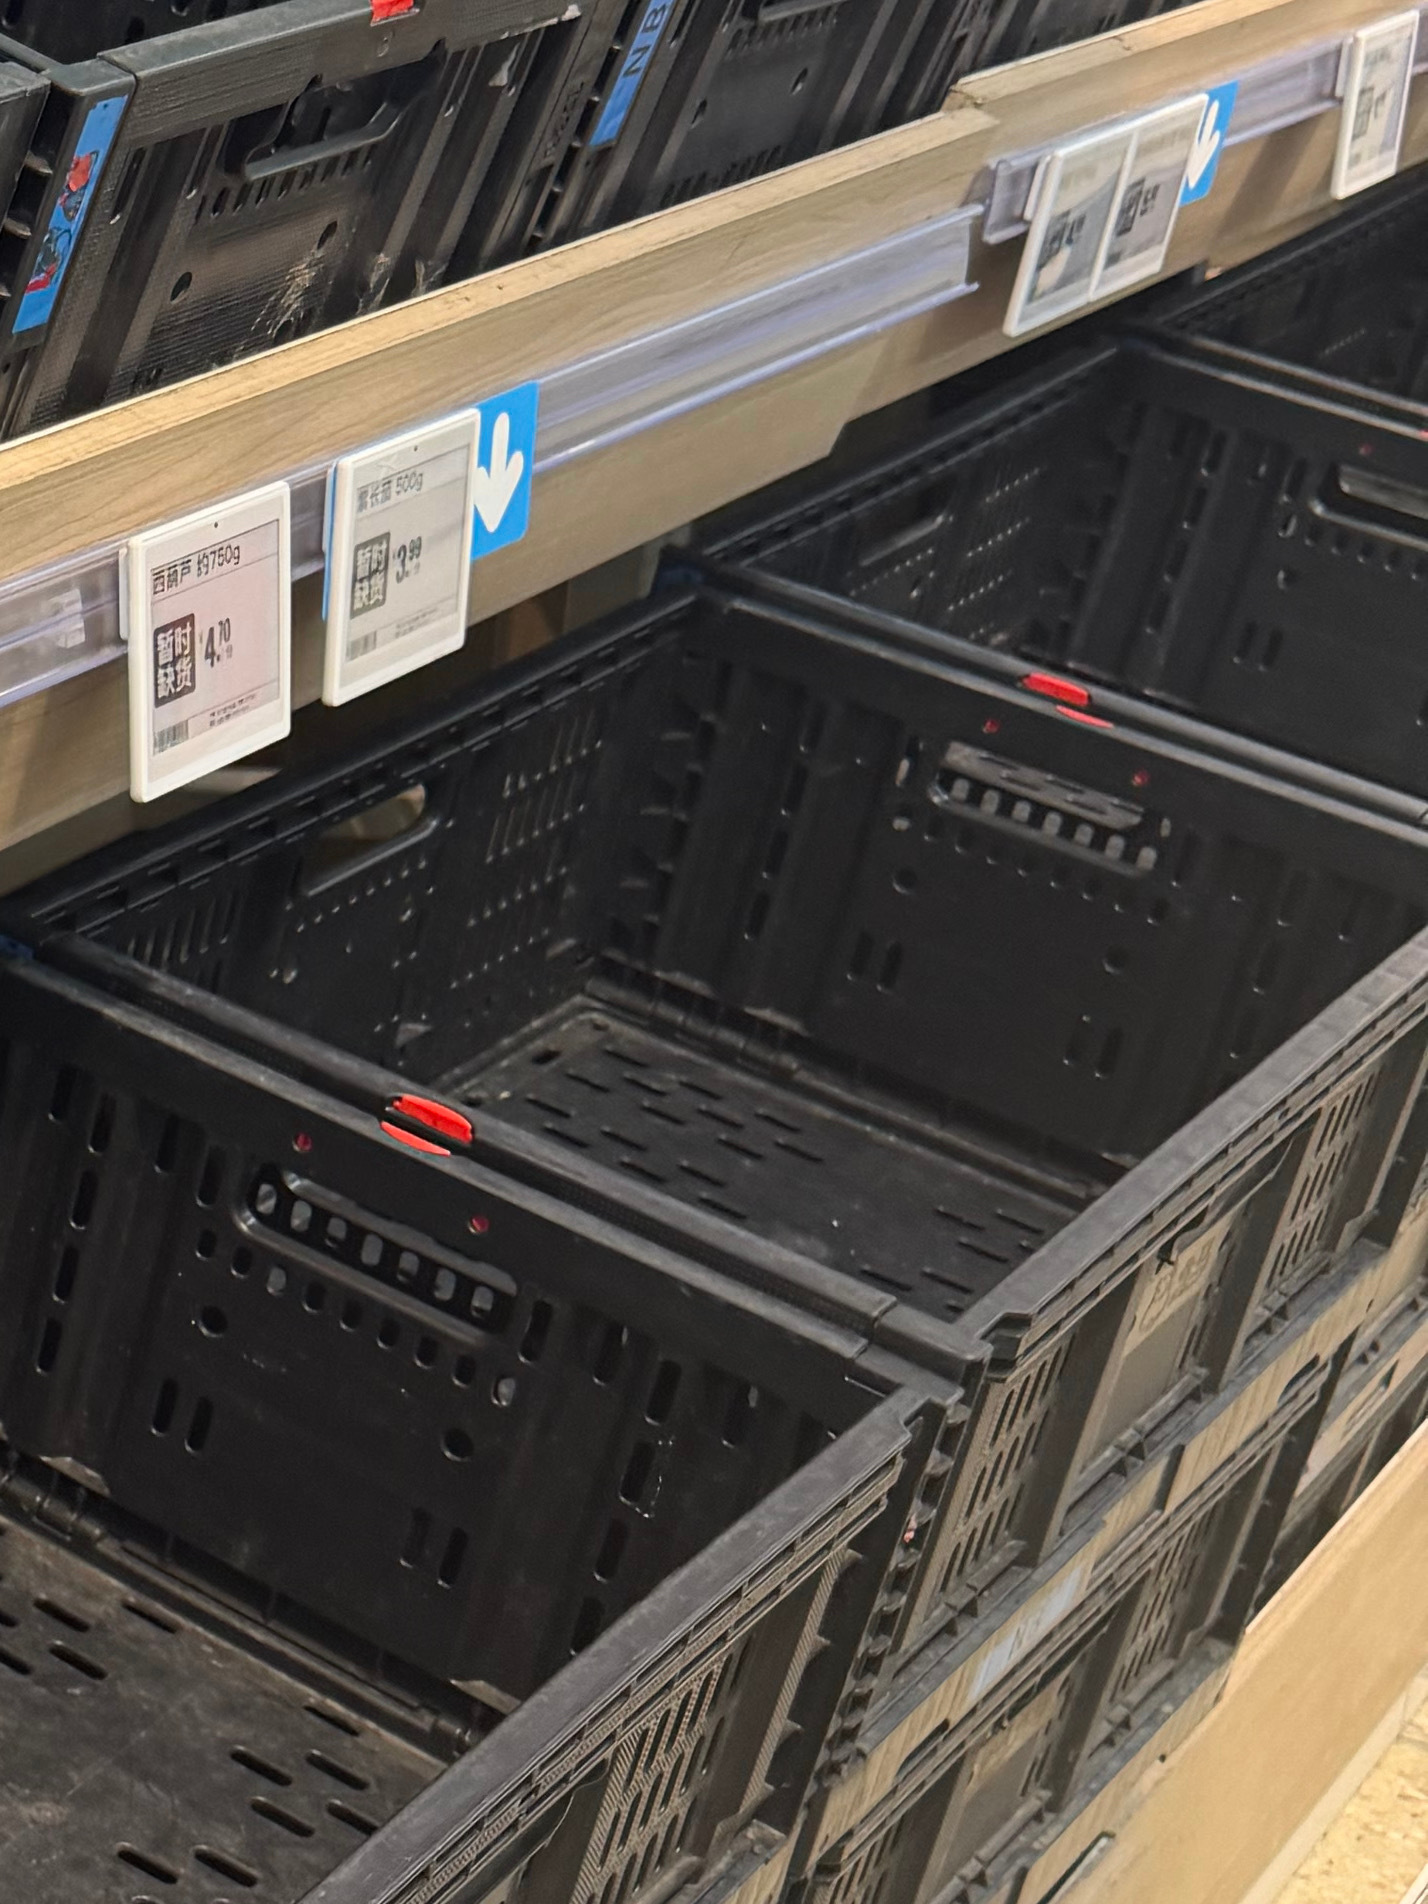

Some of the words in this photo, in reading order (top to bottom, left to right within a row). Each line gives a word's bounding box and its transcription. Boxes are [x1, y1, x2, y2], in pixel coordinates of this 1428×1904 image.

[622, 3, 668, 78] NB
[395, 470, 424, 495] 500g
[151, 560, 192, 596] 西葫芦
[197, 545, 241, 578] 约750g
[156, 619, 192, 664] 暂时
[157, 659, 192, 699] 缺货
